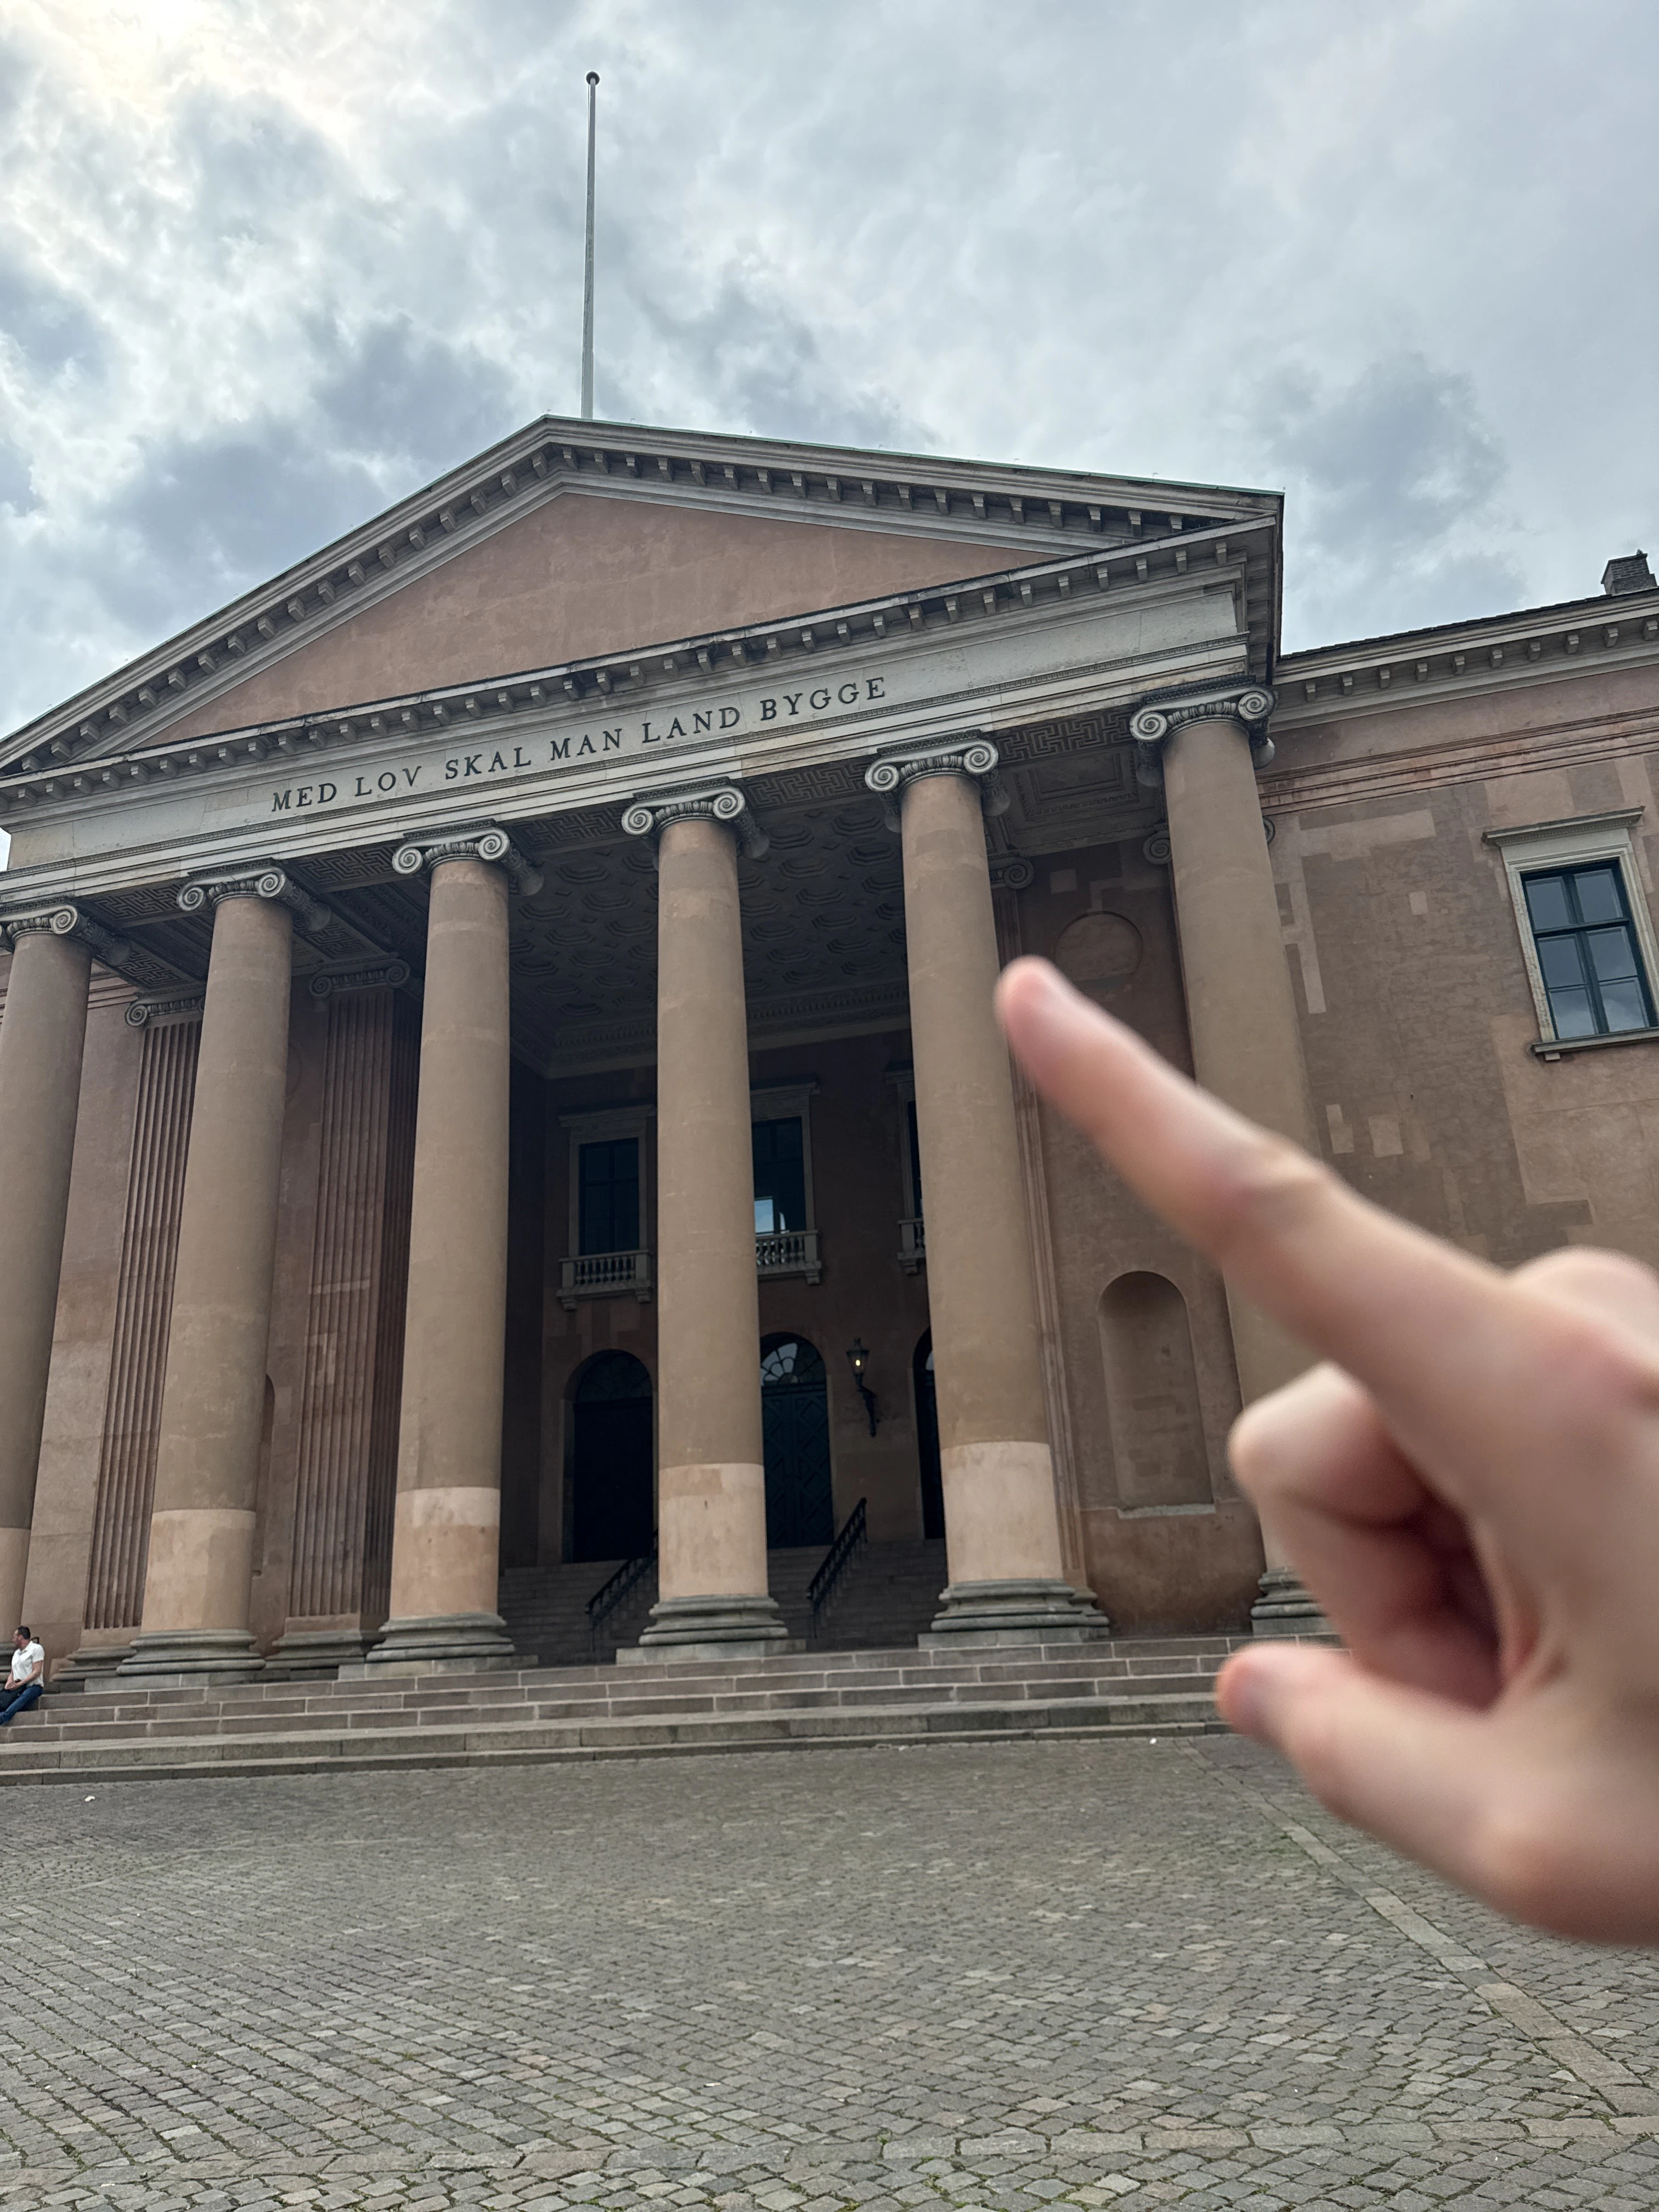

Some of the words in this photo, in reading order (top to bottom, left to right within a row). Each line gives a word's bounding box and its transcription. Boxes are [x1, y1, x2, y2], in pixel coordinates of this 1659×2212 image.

[272, 783, 337, 812] MED
[355, 766, 421, 797] LOV
[445, 747, 532, 780] SKAL
[550, 728, 622, 761] MAN
[642, 707, 741, 743] LAND
[760, 677, 885, 721] BYGGE
